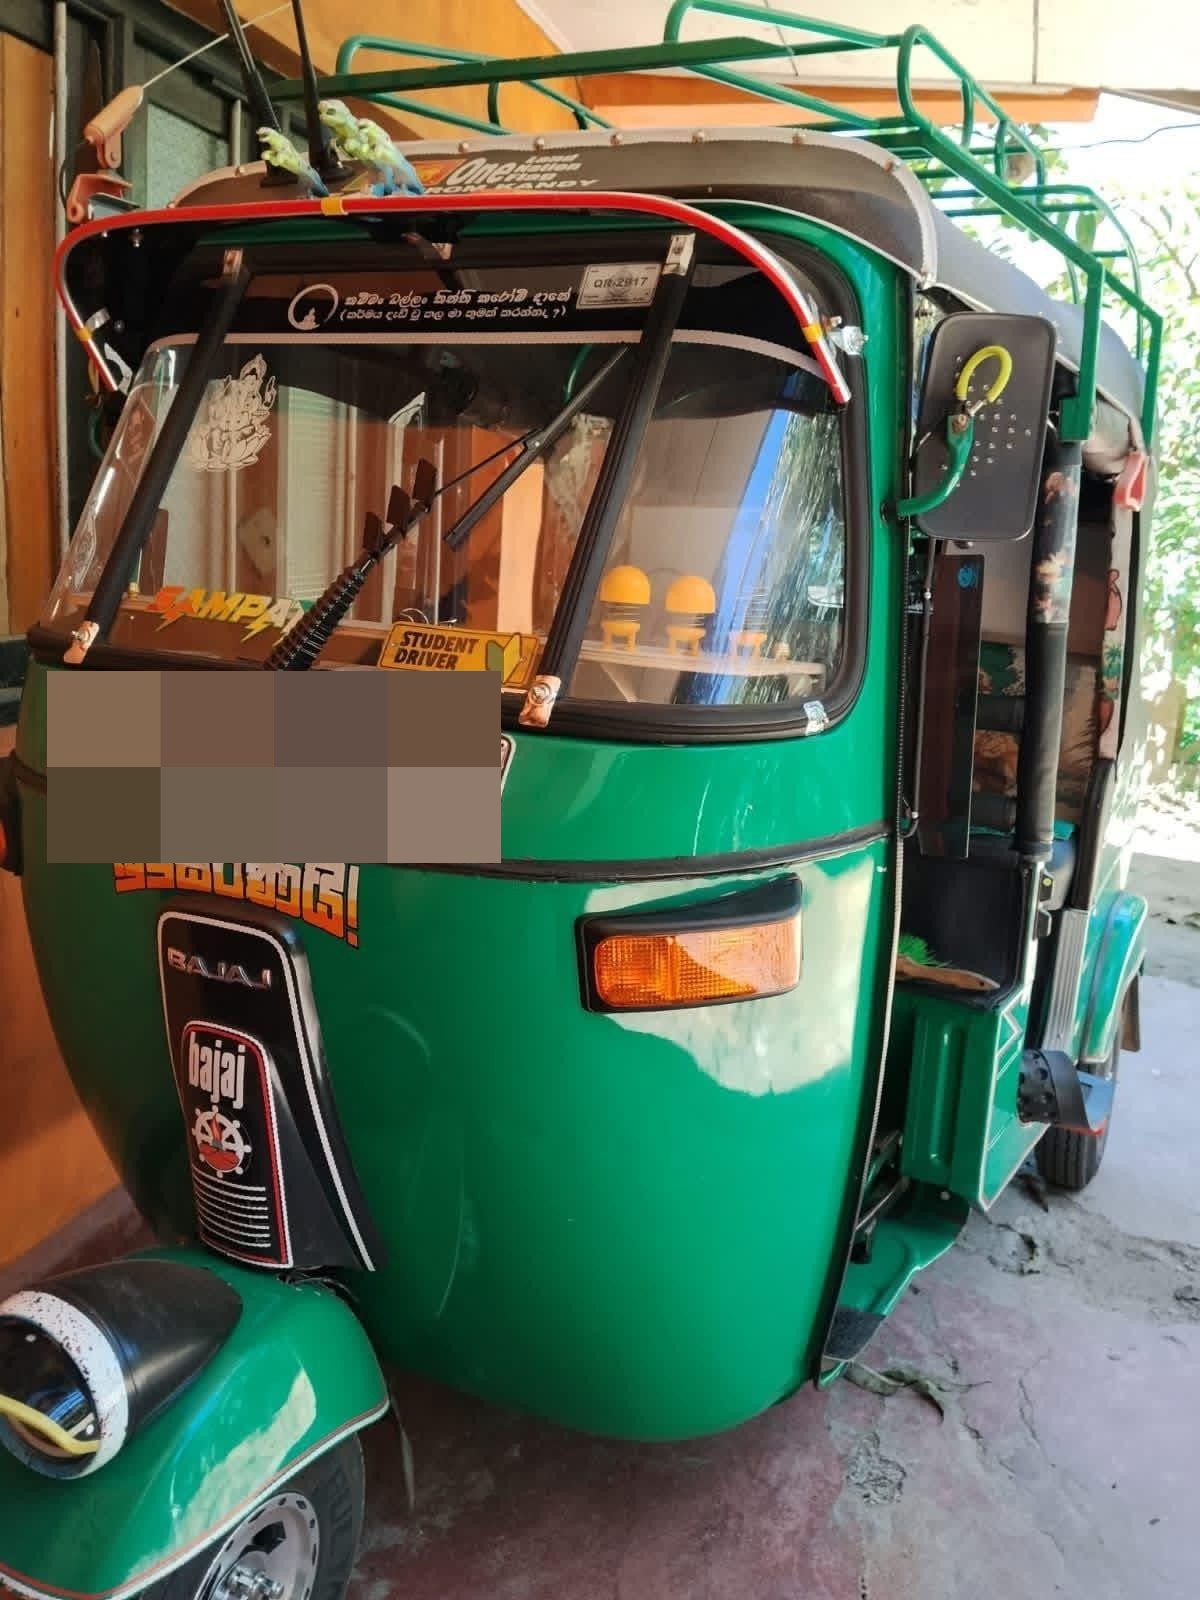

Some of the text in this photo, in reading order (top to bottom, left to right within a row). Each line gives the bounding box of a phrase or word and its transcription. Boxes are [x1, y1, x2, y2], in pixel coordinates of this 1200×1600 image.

[446, 157, 527, 185] One
[424, 179, 601, 195] ROM KANDY
[401, 630, 480, 654] STUDENT
[394, 647, 459, 671] DRIVER
[167, 946, 272, 991] BAJAJ
[188, 1030, 246, 1110] bajaj
